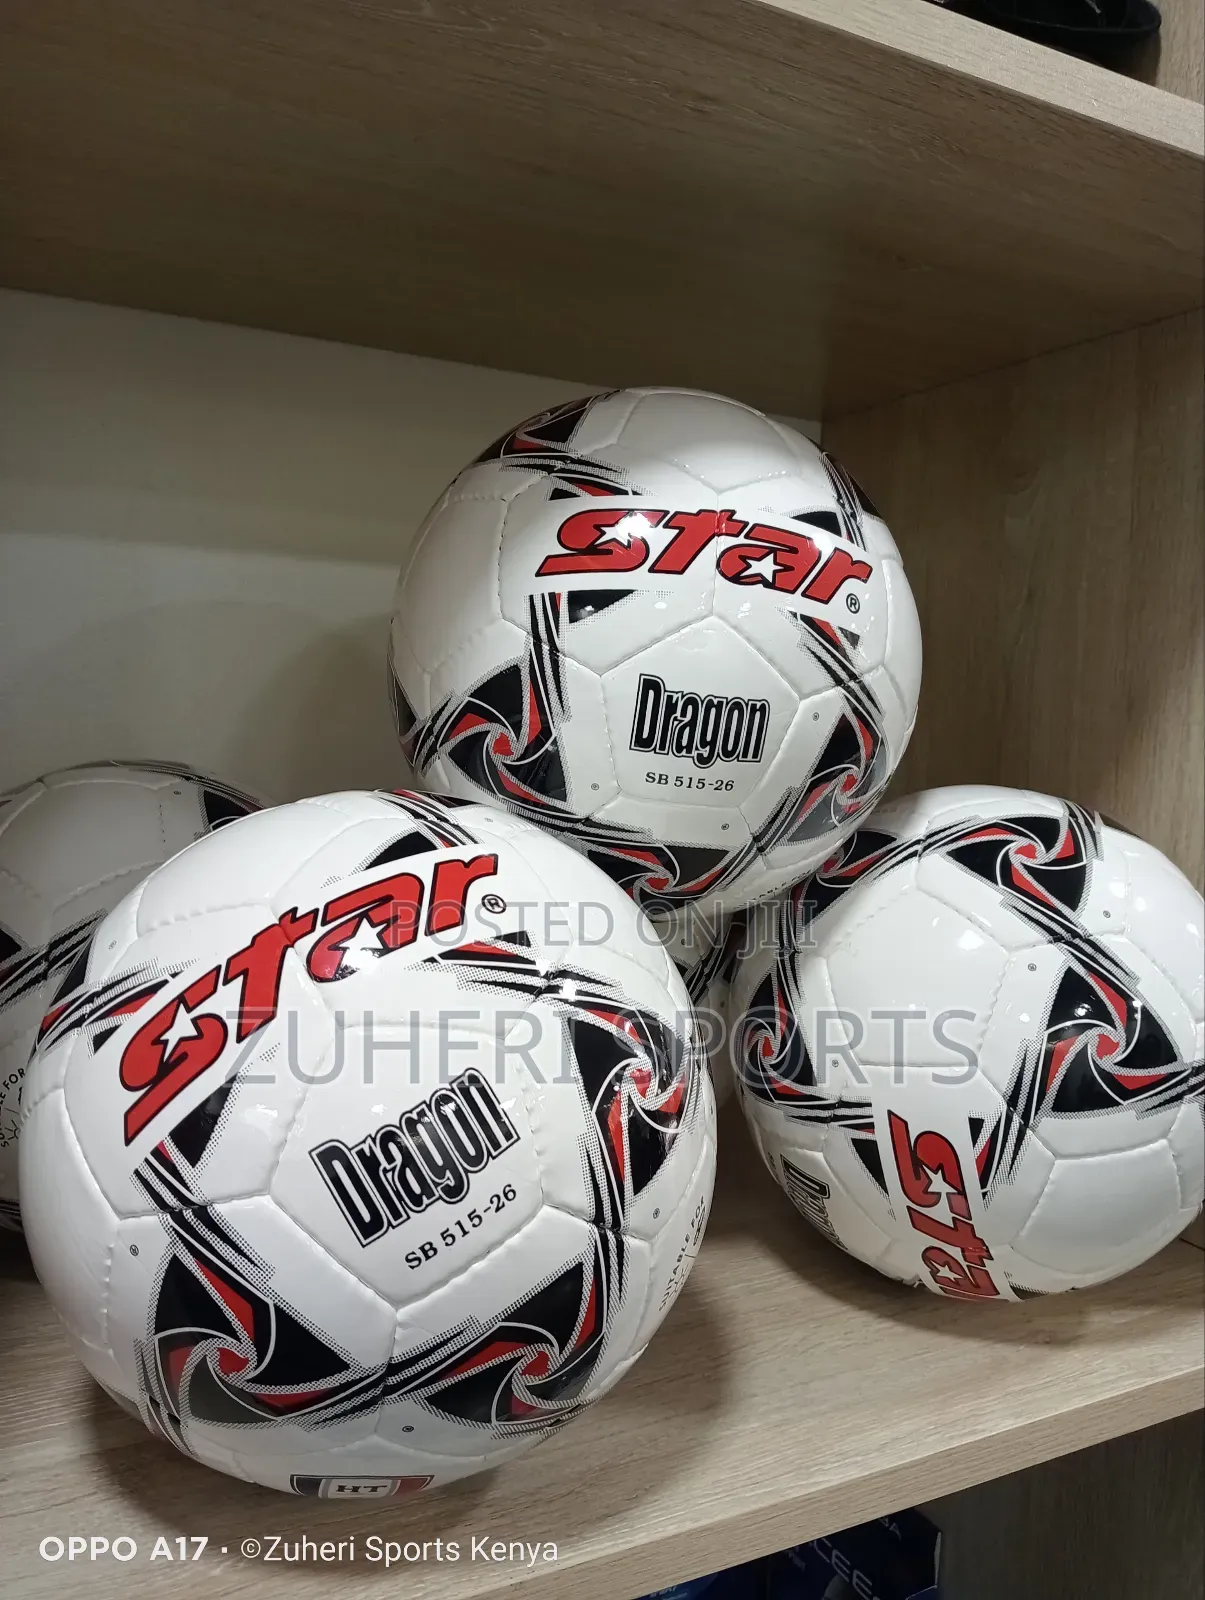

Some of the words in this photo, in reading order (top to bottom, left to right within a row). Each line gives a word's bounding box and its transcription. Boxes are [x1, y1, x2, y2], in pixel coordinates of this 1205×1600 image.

[629, 673, 770, 769] Dragon
[645, 772, 669, 786] SB
[674, 776, 735, 791] 515-26
[308, 1066, 520, 1248] Dragon
[404, 1241, 438, 1271] SB
[441, 1183, 518, 1248] 515-26
